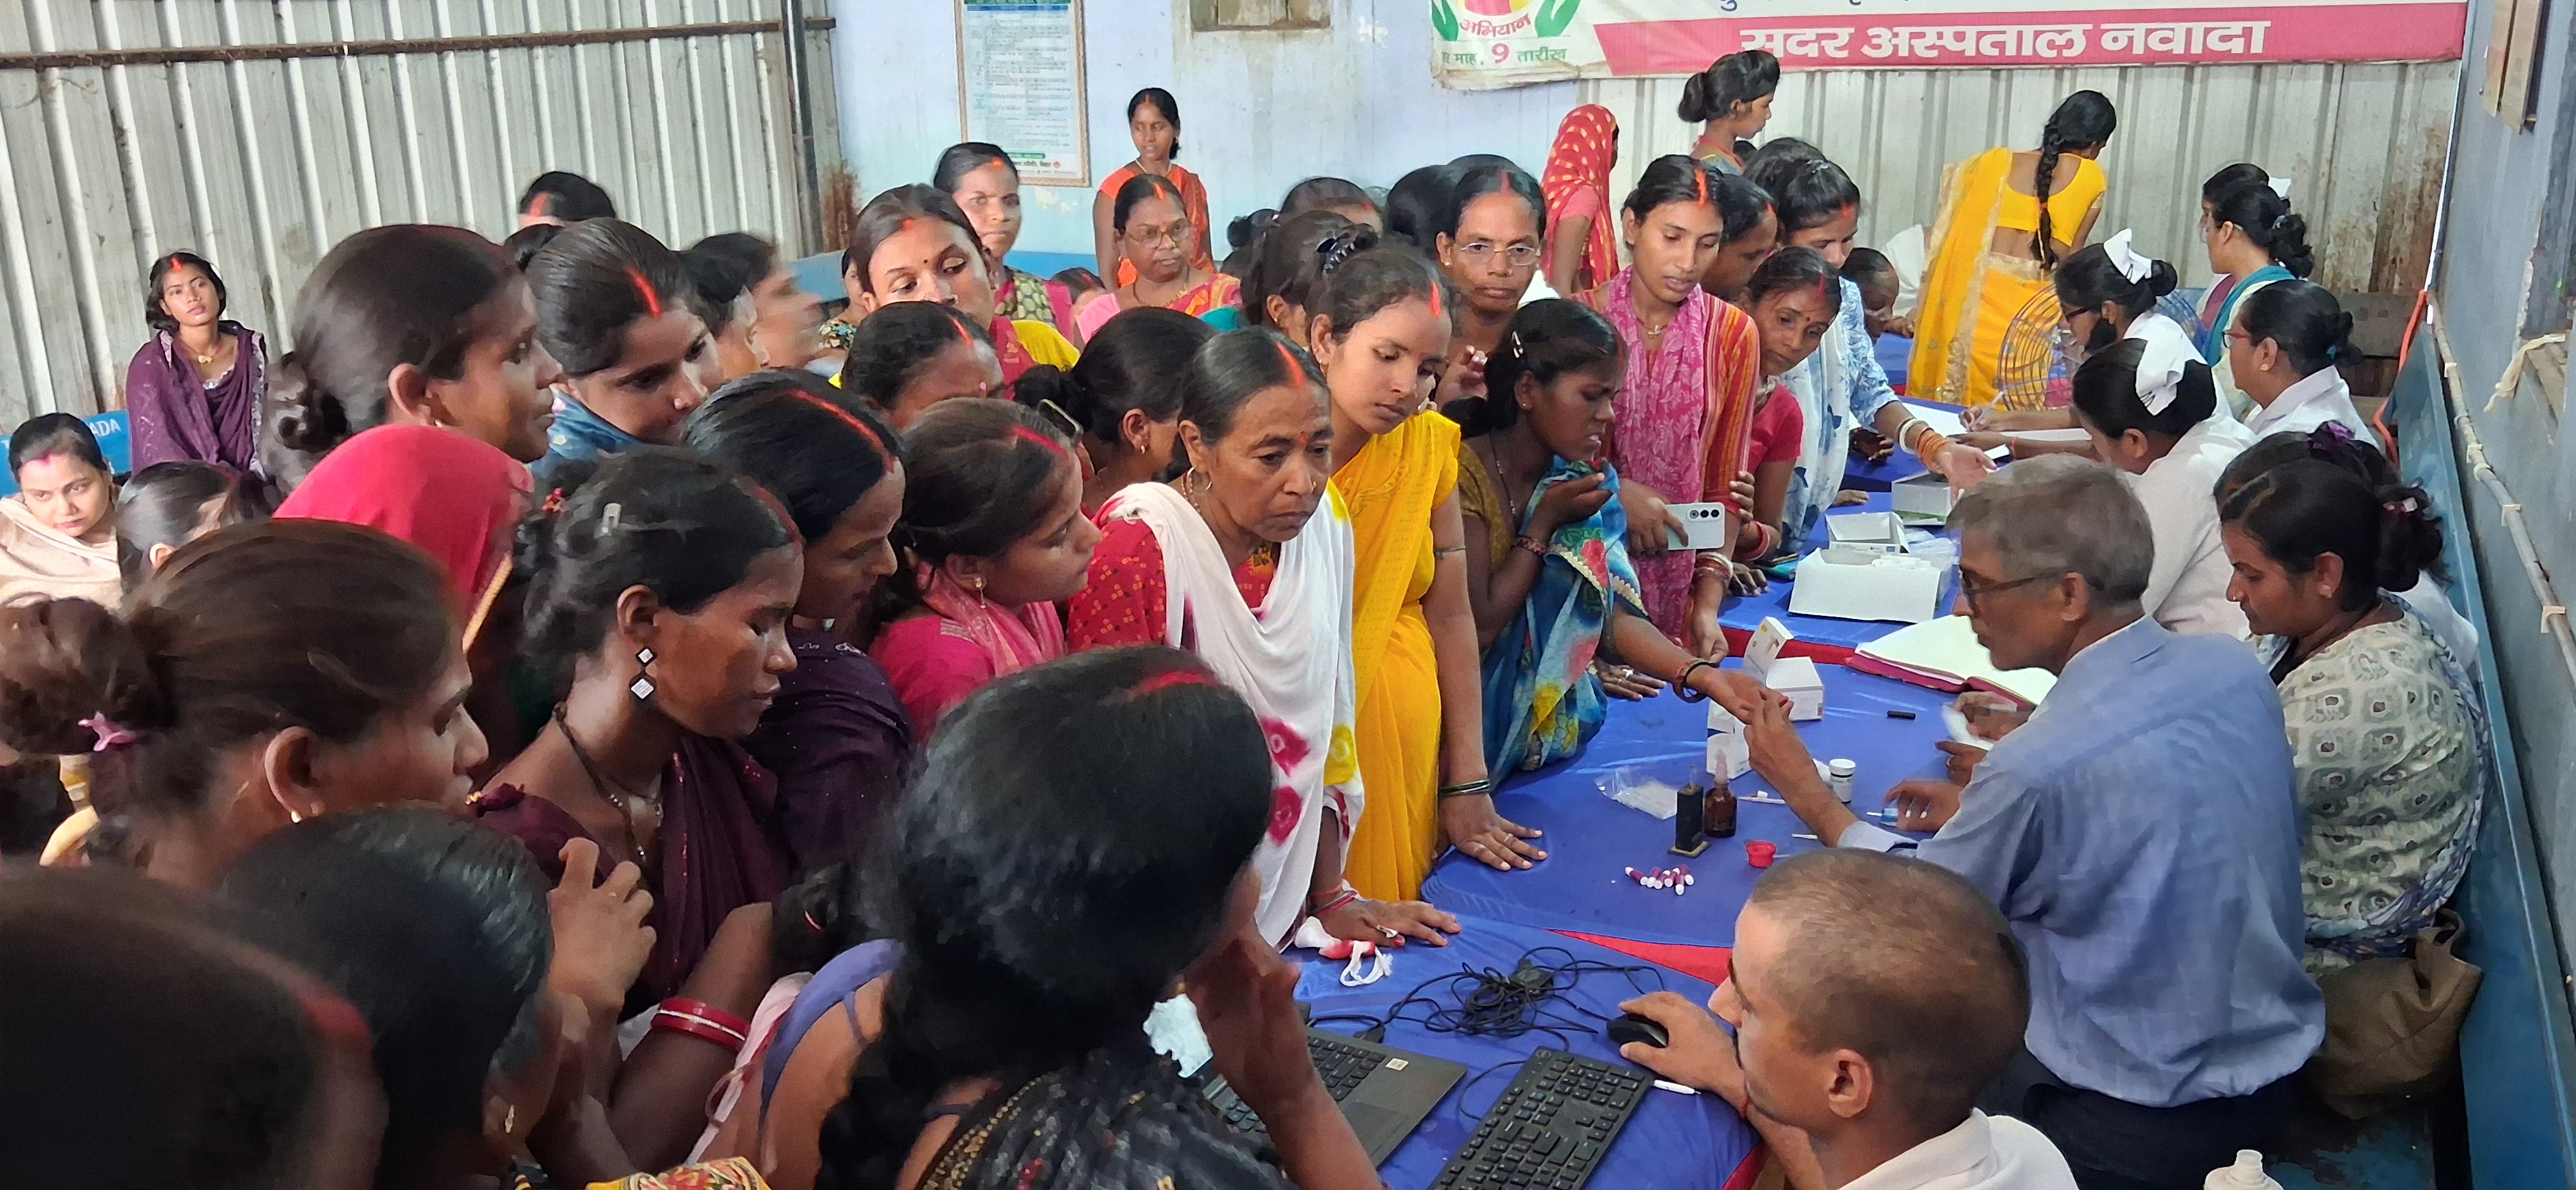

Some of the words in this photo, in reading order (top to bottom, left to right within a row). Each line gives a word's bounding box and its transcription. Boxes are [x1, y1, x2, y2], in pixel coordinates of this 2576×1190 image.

[1459, 13, 1531, 37] अभियान
[1739, 27, 1855, 57] सदर
[1861, 23, 2092, 58] अस्पताल
[2100, 20, 2271, 56] नवादा
[1491, 42, 1510, 63] 9
[1517, 45, 1567, 62] तारीख
[90, 418, 121, 437] ADA
